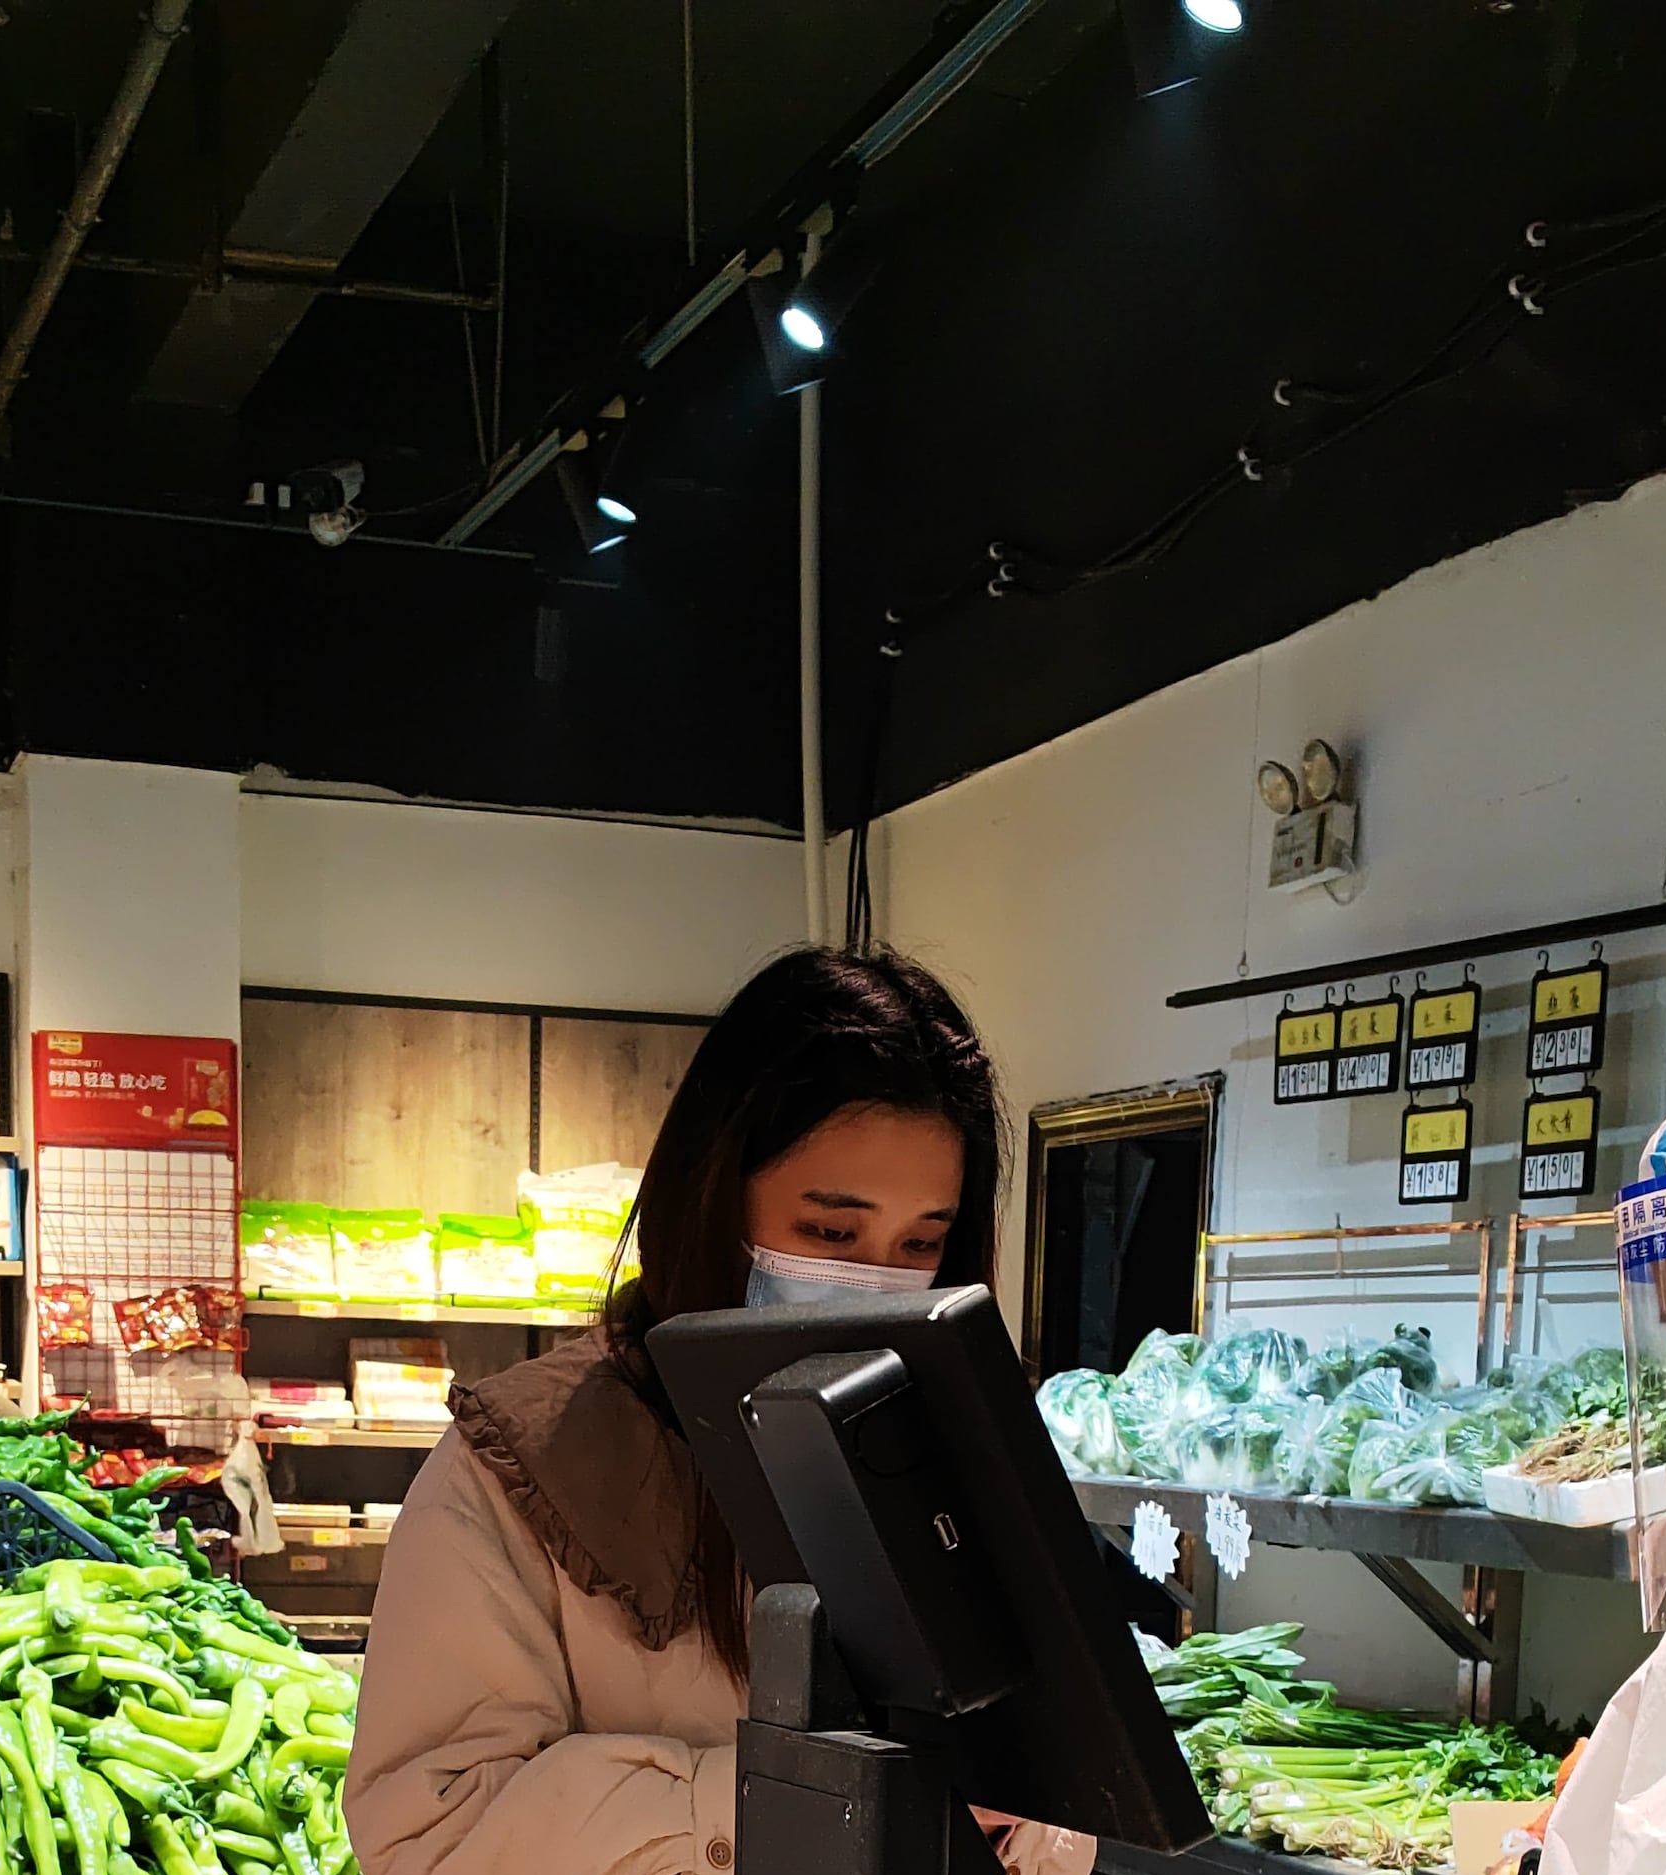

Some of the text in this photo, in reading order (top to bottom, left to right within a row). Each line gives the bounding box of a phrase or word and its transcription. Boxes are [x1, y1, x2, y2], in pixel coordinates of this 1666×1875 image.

[48, 1070, 167, 1090] 鲜脆 轻盐 放心吃
